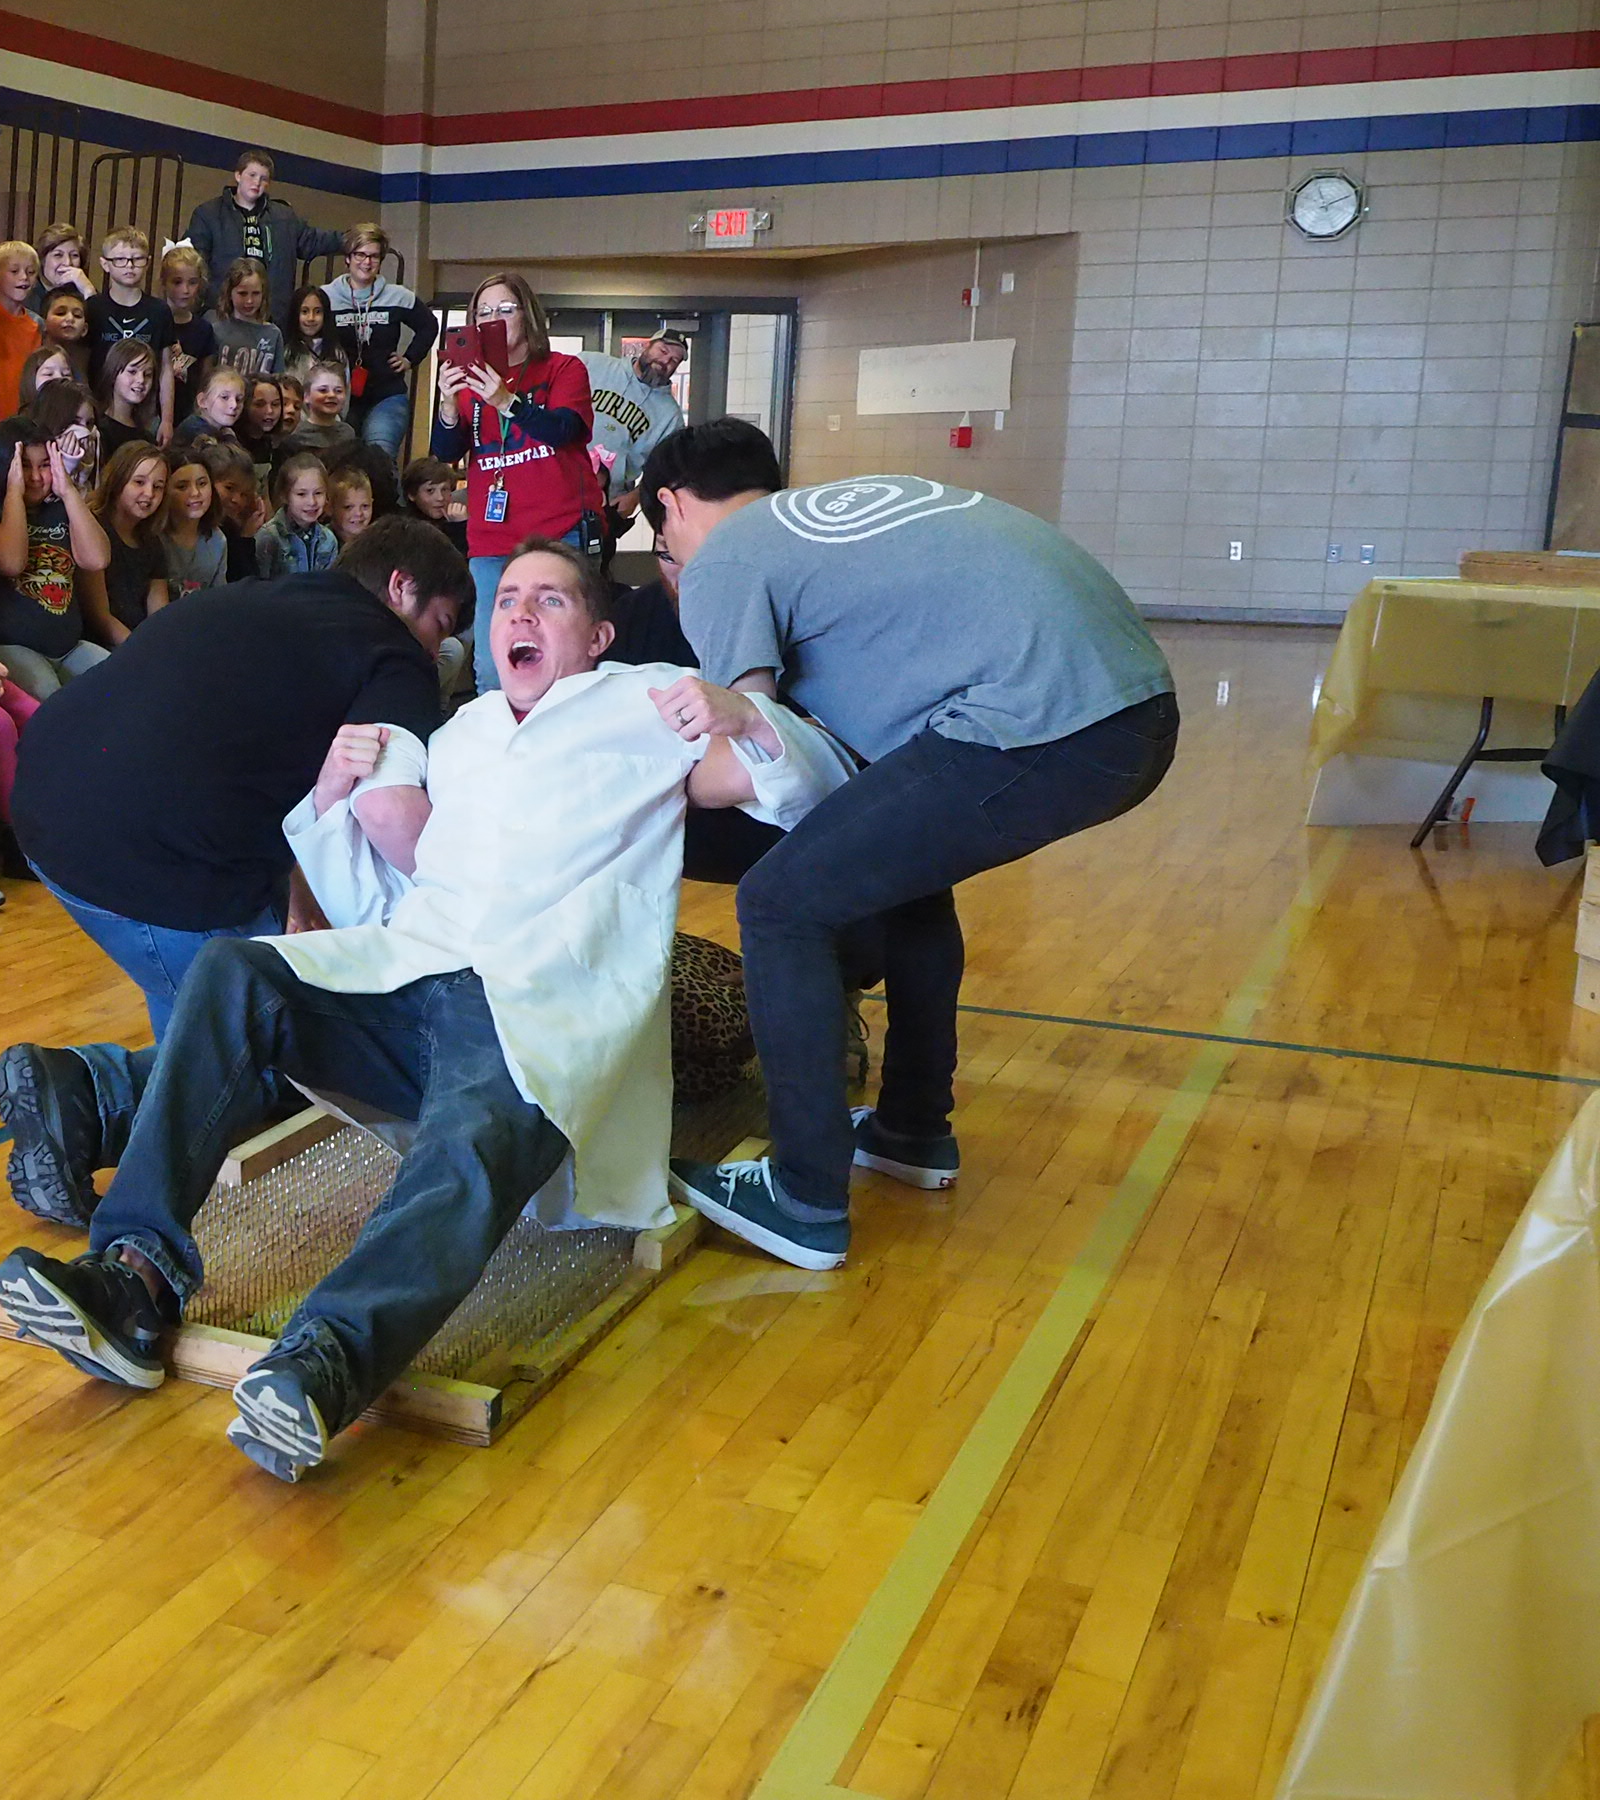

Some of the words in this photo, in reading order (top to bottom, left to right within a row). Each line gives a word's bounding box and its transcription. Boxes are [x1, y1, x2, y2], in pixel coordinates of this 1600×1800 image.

[715, 210, 749, 237] EXIT
[473, 402, 481, 448] LESTER
[592, 388, 650, 445] PURDUE
[477, 444, 556, 472] LEMENTARY
[824, 486, 877, 514] SPS
